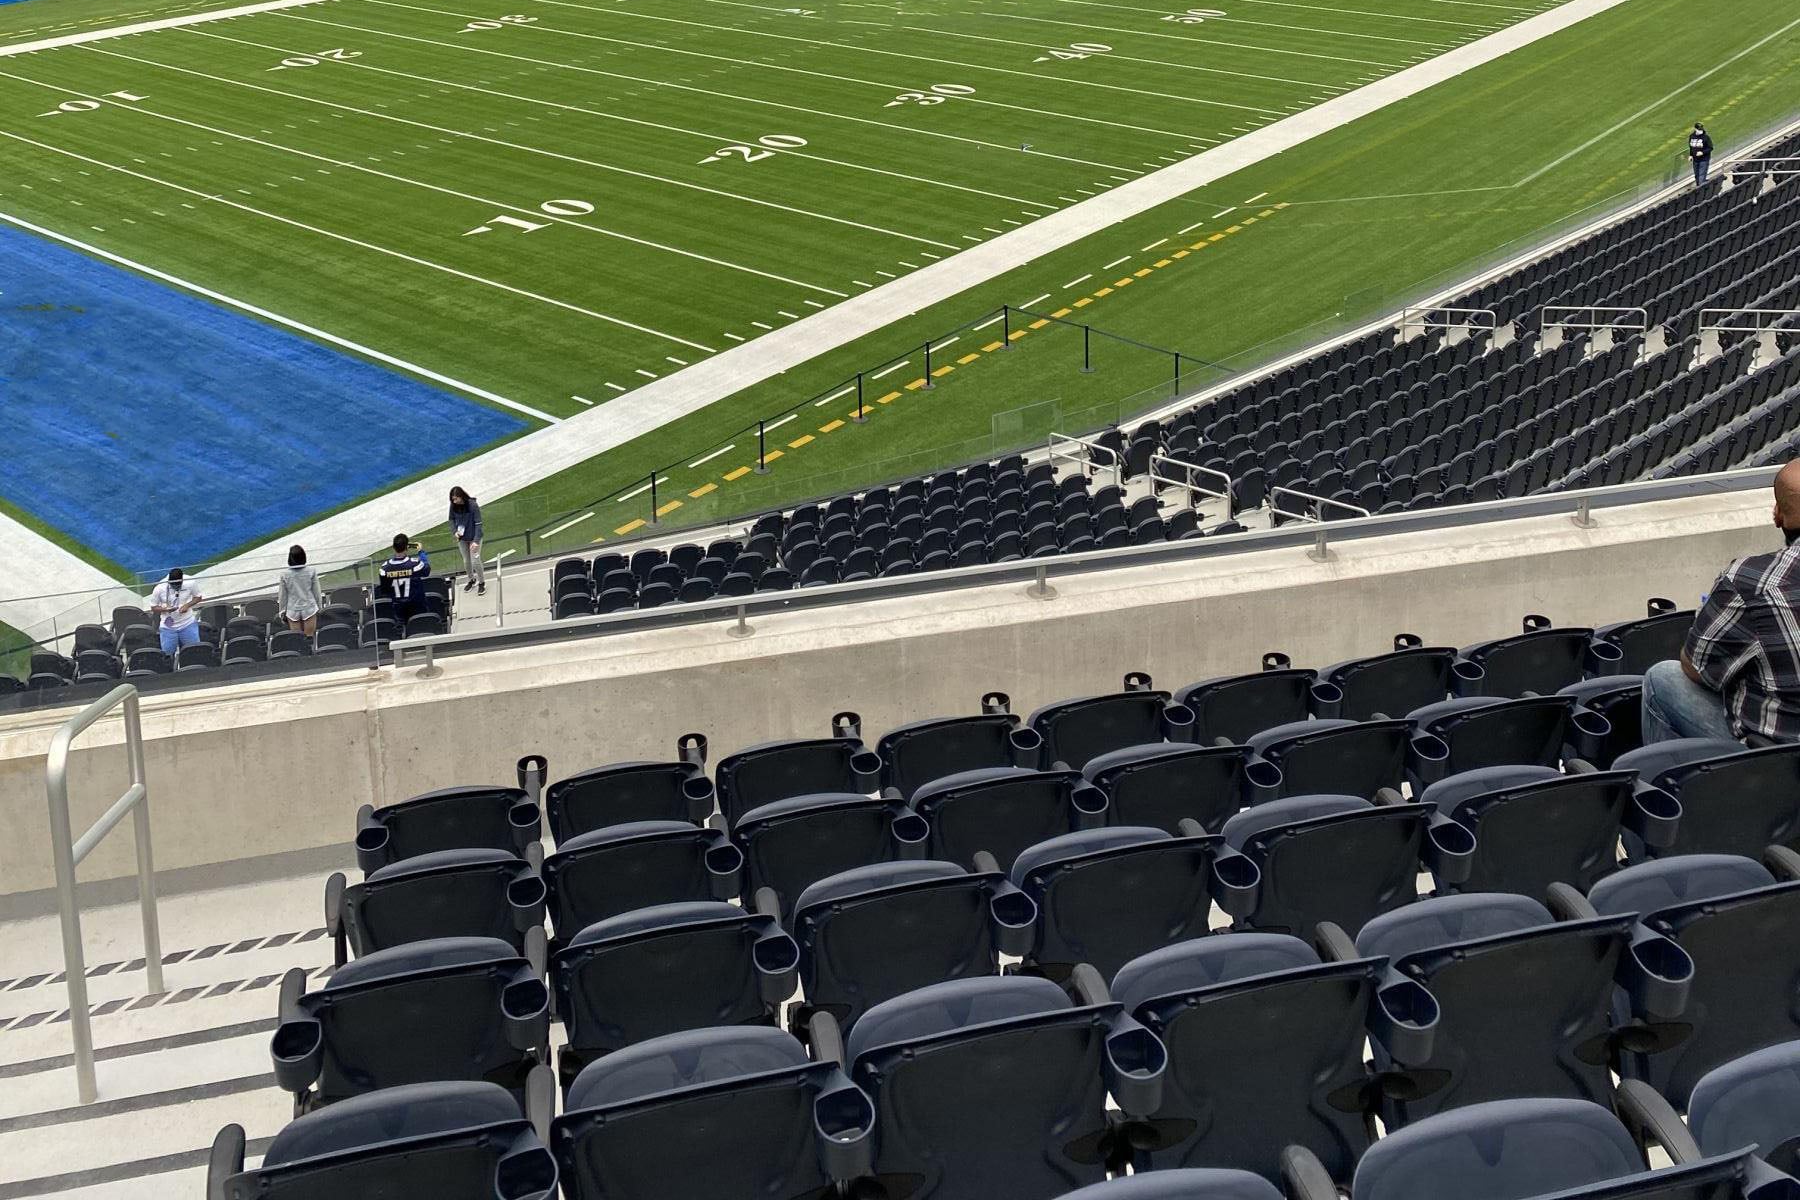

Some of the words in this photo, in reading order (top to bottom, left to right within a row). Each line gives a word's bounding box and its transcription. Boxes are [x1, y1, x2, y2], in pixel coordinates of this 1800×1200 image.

[1162, 9, 1227, 23] 50
[1048, 43, 1113, 60] 40
[896, 83, 976, 105] 30
[715, 134, 808, 162] 20
[486, 199, 595, 233] 10
[392, 578, 411, 598] 17
